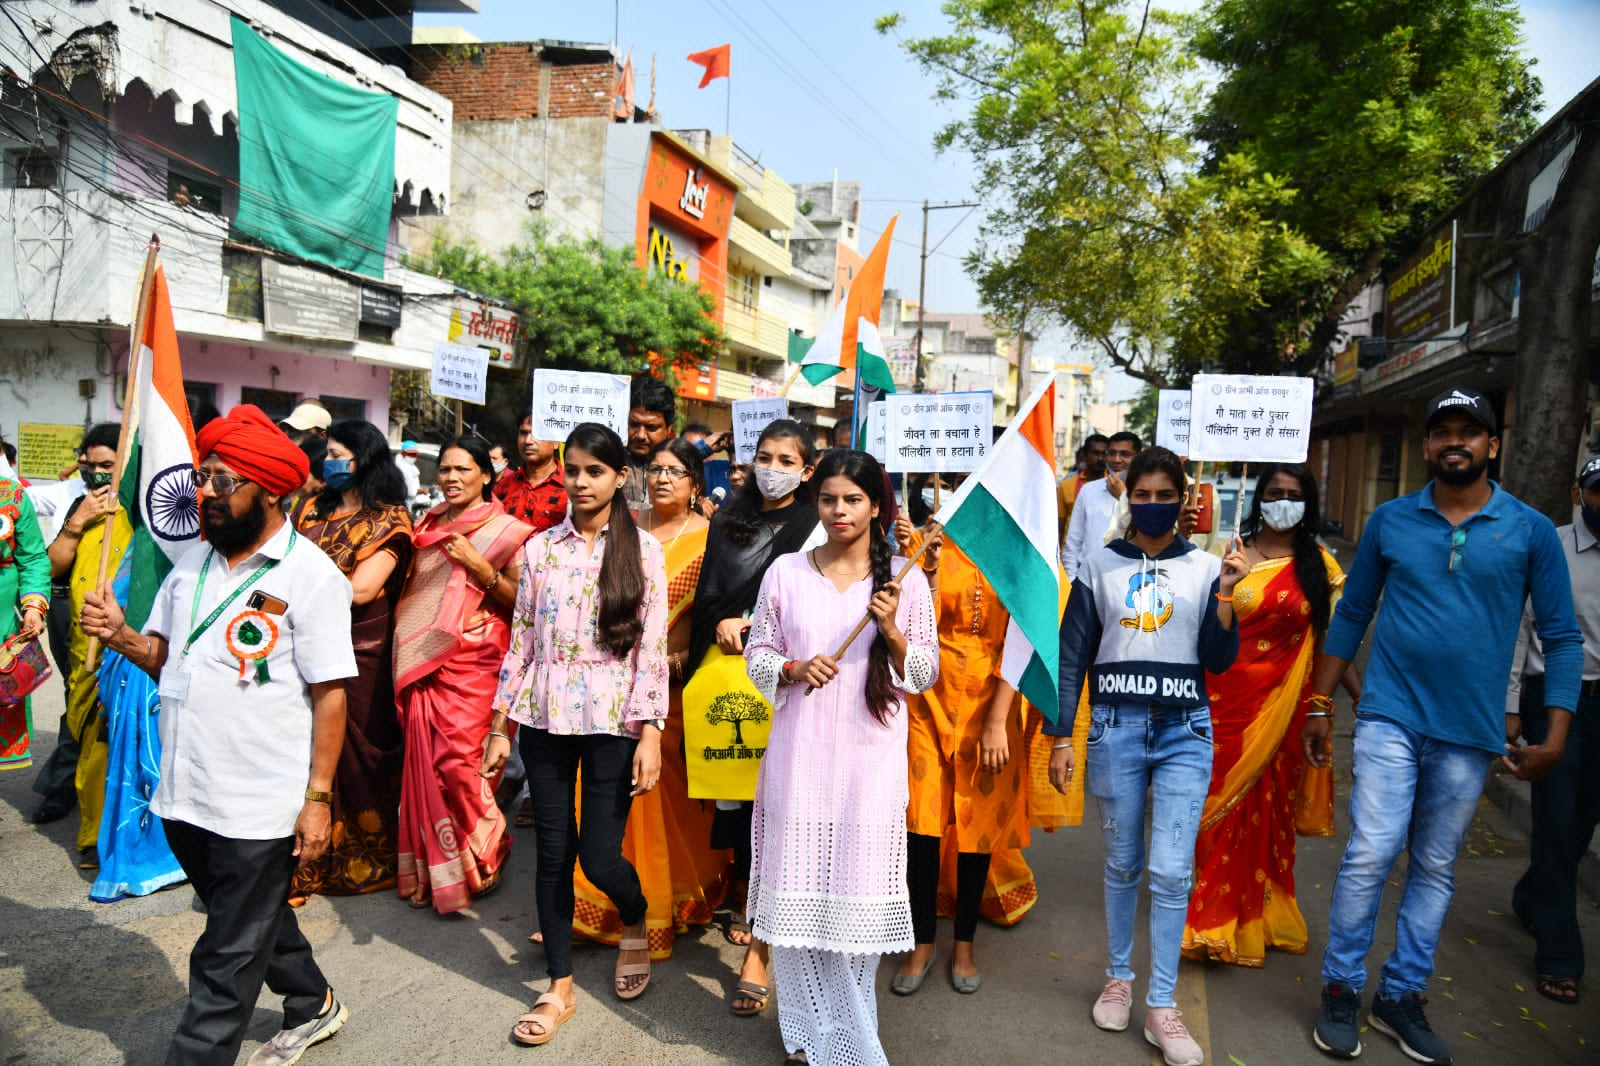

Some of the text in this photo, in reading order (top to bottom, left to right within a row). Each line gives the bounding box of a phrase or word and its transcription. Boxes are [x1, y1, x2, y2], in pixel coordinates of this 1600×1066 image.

[1230, 410, 1247, 420] माता
[1252, 408, 1265, 420] करें
[1270, 411, 1289, 424] पुकार
[904, 427, 926, 440] जीवन
[930, 430, 940, 440] ला
[1206, 423, 1300, 441] पॉलिथीन मुक्त हो संसार
[899, 444, 932, 457] पॉलिथीन
[936, 448, 946, 457] ला
[952, 447, 974, 457] हटाना
[1098, 674, 1199, 700] DONALD DUCK
